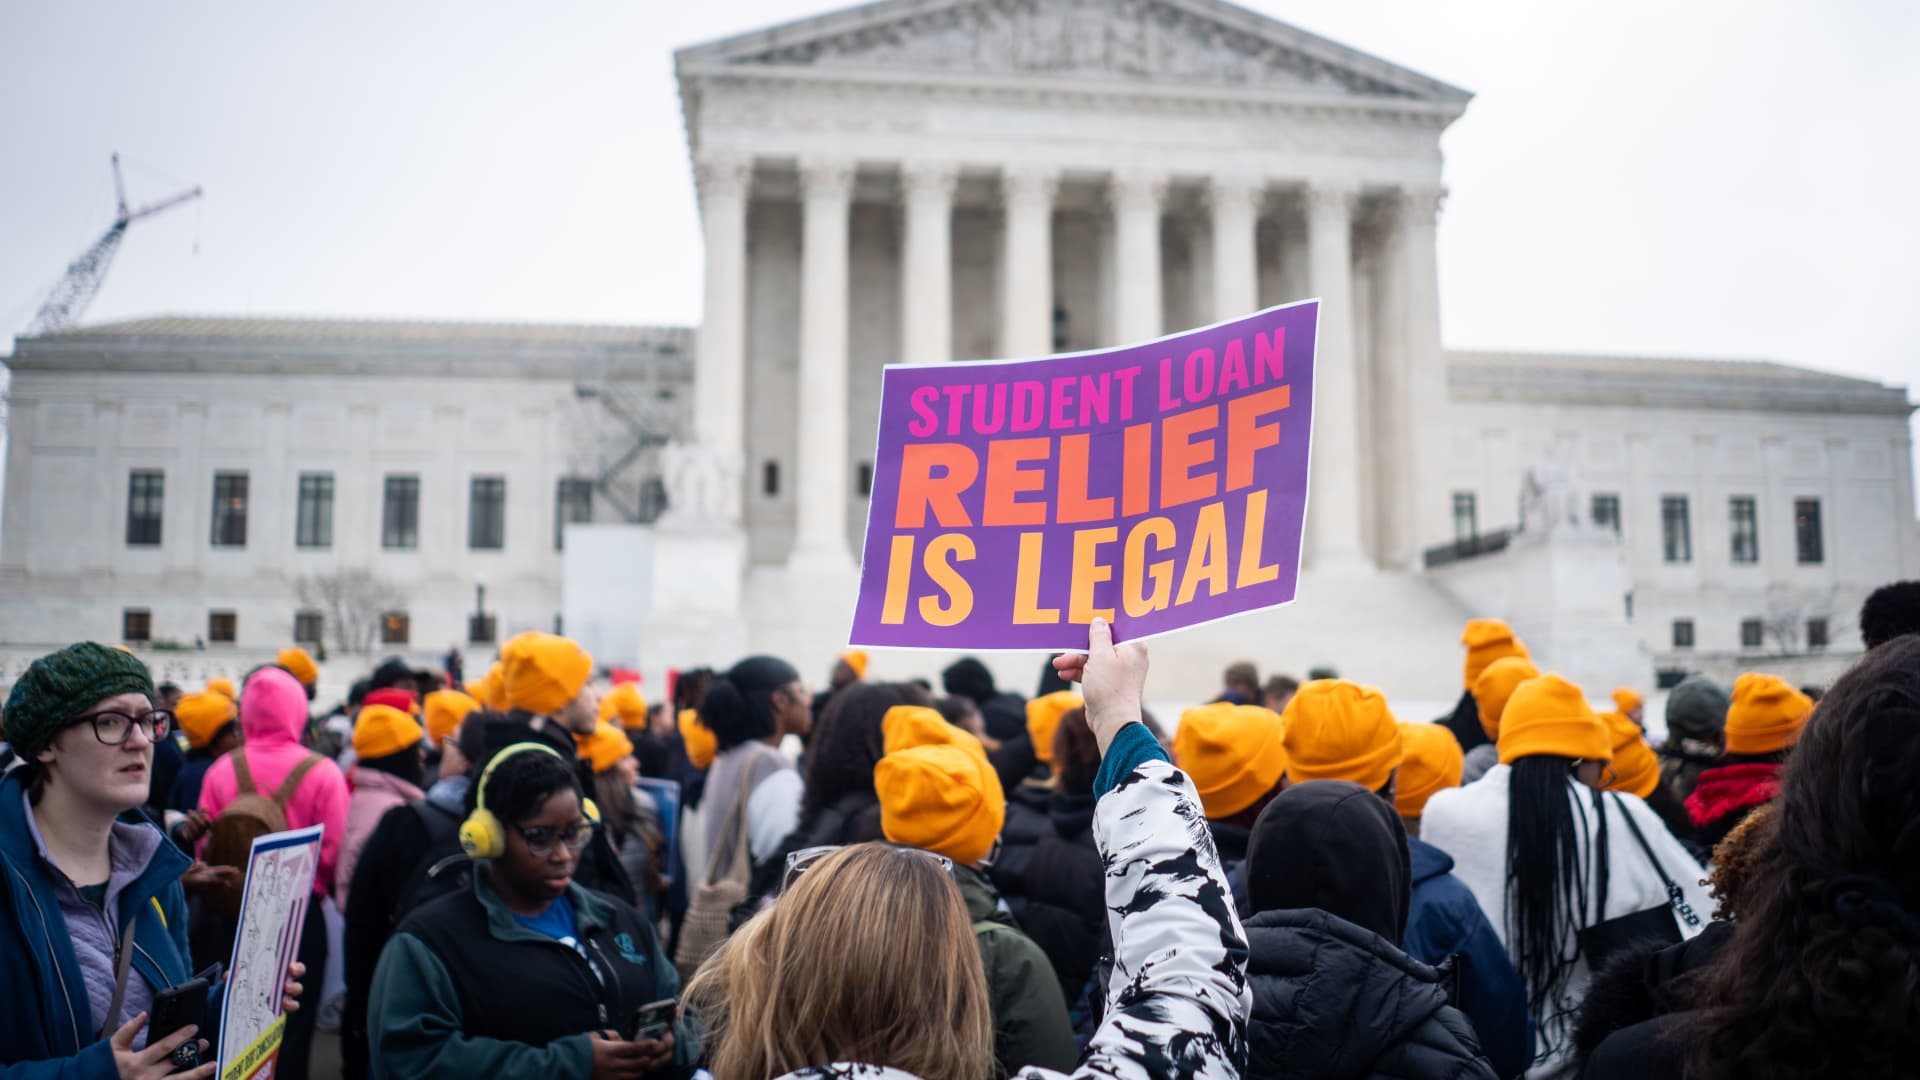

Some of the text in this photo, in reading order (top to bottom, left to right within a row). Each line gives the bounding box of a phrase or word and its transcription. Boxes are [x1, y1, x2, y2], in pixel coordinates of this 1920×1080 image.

[908, 327, 1286, 438] STUDENT LOAN
[894, 383, 1290, 528] RELIEF
[880, 489, 1280, 627] IS LEGAL
